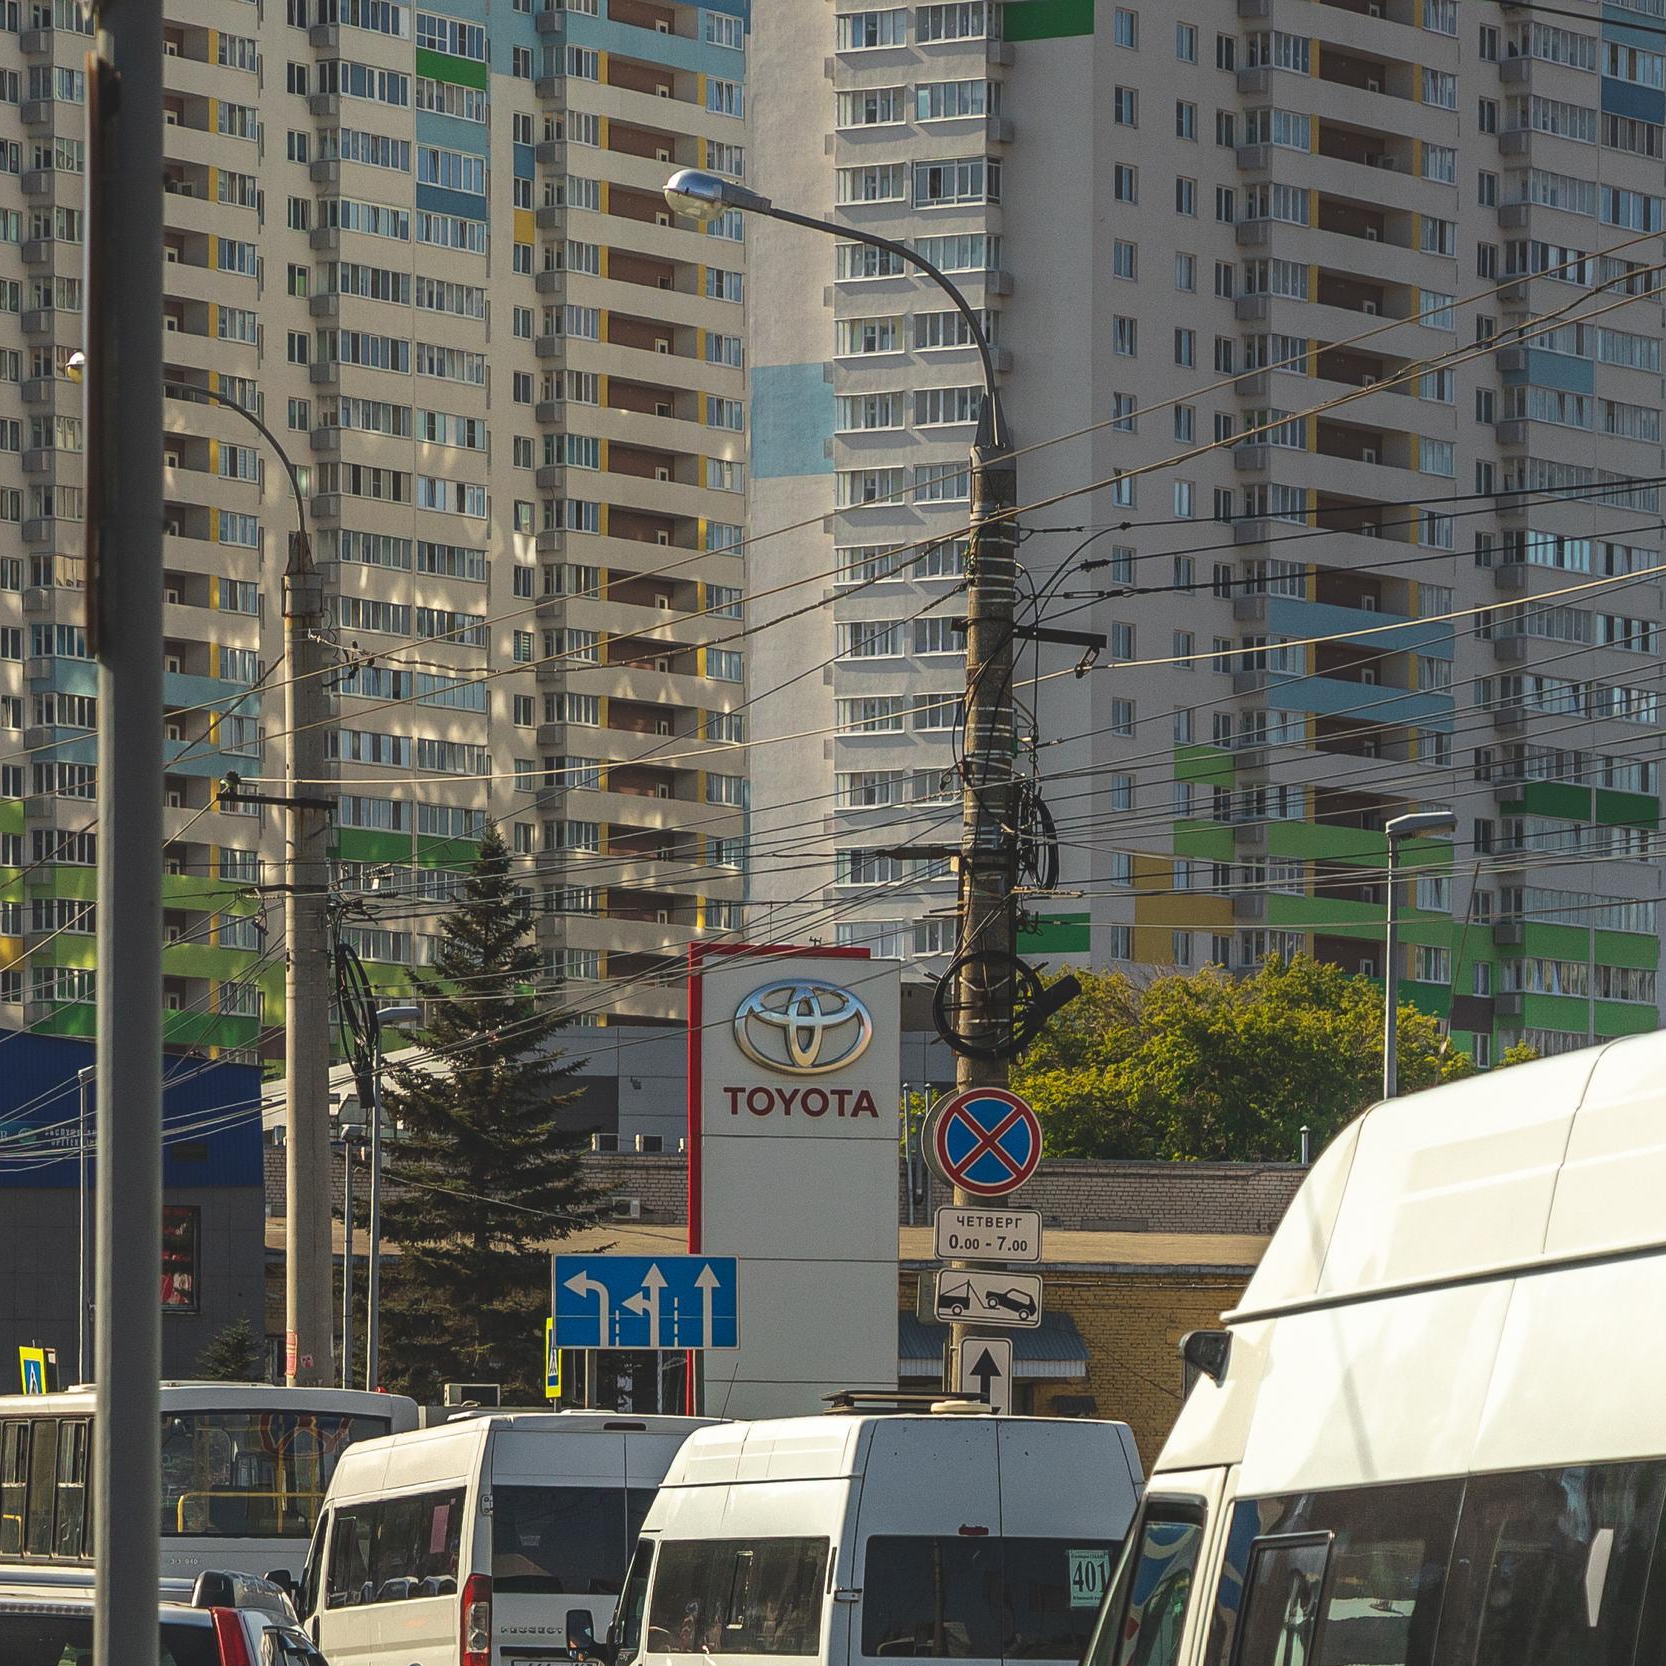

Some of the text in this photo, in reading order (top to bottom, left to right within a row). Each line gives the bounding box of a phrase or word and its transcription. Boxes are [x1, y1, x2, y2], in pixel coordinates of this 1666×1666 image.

[723, 1086, 879, 1117] TOYOTA
[956, 1215, 1022, 1228] ЧЕТВЕРГ
[949, 1234, 979, 1249] 0.00
[997, 1236, 1027, 1251] 7.00
[1073, 1561, 1106, 1593] 401
